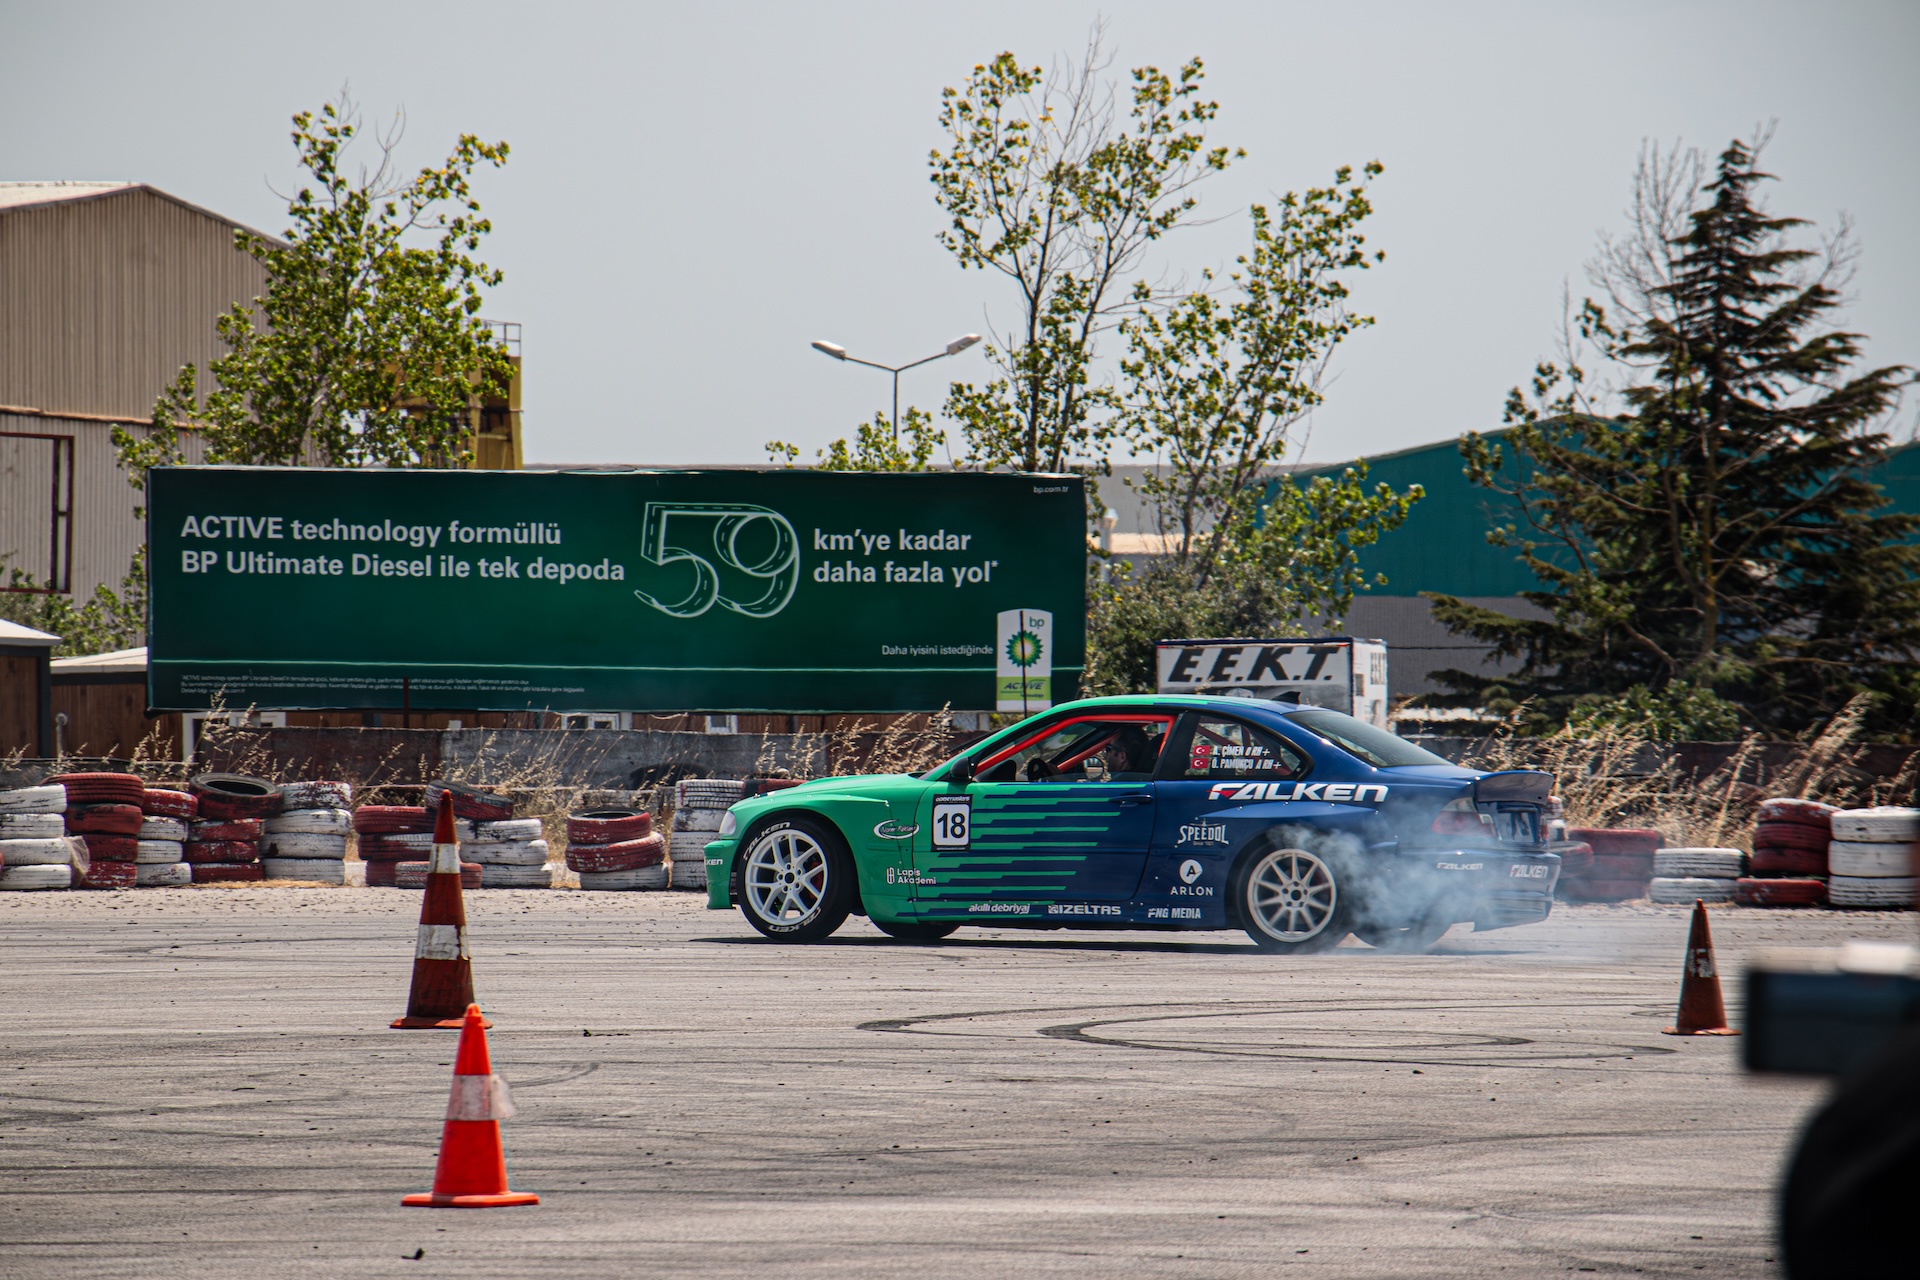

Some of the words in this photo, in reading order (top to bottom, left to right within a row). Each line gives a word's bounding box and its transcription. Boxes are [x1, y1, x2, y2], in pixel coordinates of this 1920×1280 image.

[1033, 486, 1069, 494] bp.com.tr
[180, 515, 284, 538] ACTIVE
[290, 518, 442, 548] technology
[448, 520, 561, 545] formüllü
[899, 529, 972, 551] kadar
[633, 501, 799, 618] 59
[181, 550, 218, 573] BP
[226, 551, 344, 575] Ultimate
[352, 553, 432, 577] Diesel
[440, 555, 470, 578] ile
[477, 555, 520, 578] tek
[526, 556, 625, 585] depoda
[813, 560, 877, 583] daha
[883, 560, 944, 583] fazla
[1029, 617, 1045, 629] bp
[882, 645, 908, 655] Daha
[909, 645, 938, 657] iyisini
[939, 645, 994, 657] istediğinde
[1168, 646, 1341, 683] E.E.K.T.
[1207, 783, 1390, 803] FALKEN
[937, 813, 966, 839] 18
[1177, 824, 1230, 845] SPEEDOL
[897, 868, 921, 878] Lapis
[1436, 863, 1484, 871] FALKEN
[1509, 864, 1549, 878] FALKEN
[897, 876, 937, 885] Akademi
[1170, 886, 1213, 896] ARLON
[991, 903, 1030, 914] debriyaj
[1171, 908, 1202, 919] MEDIA
